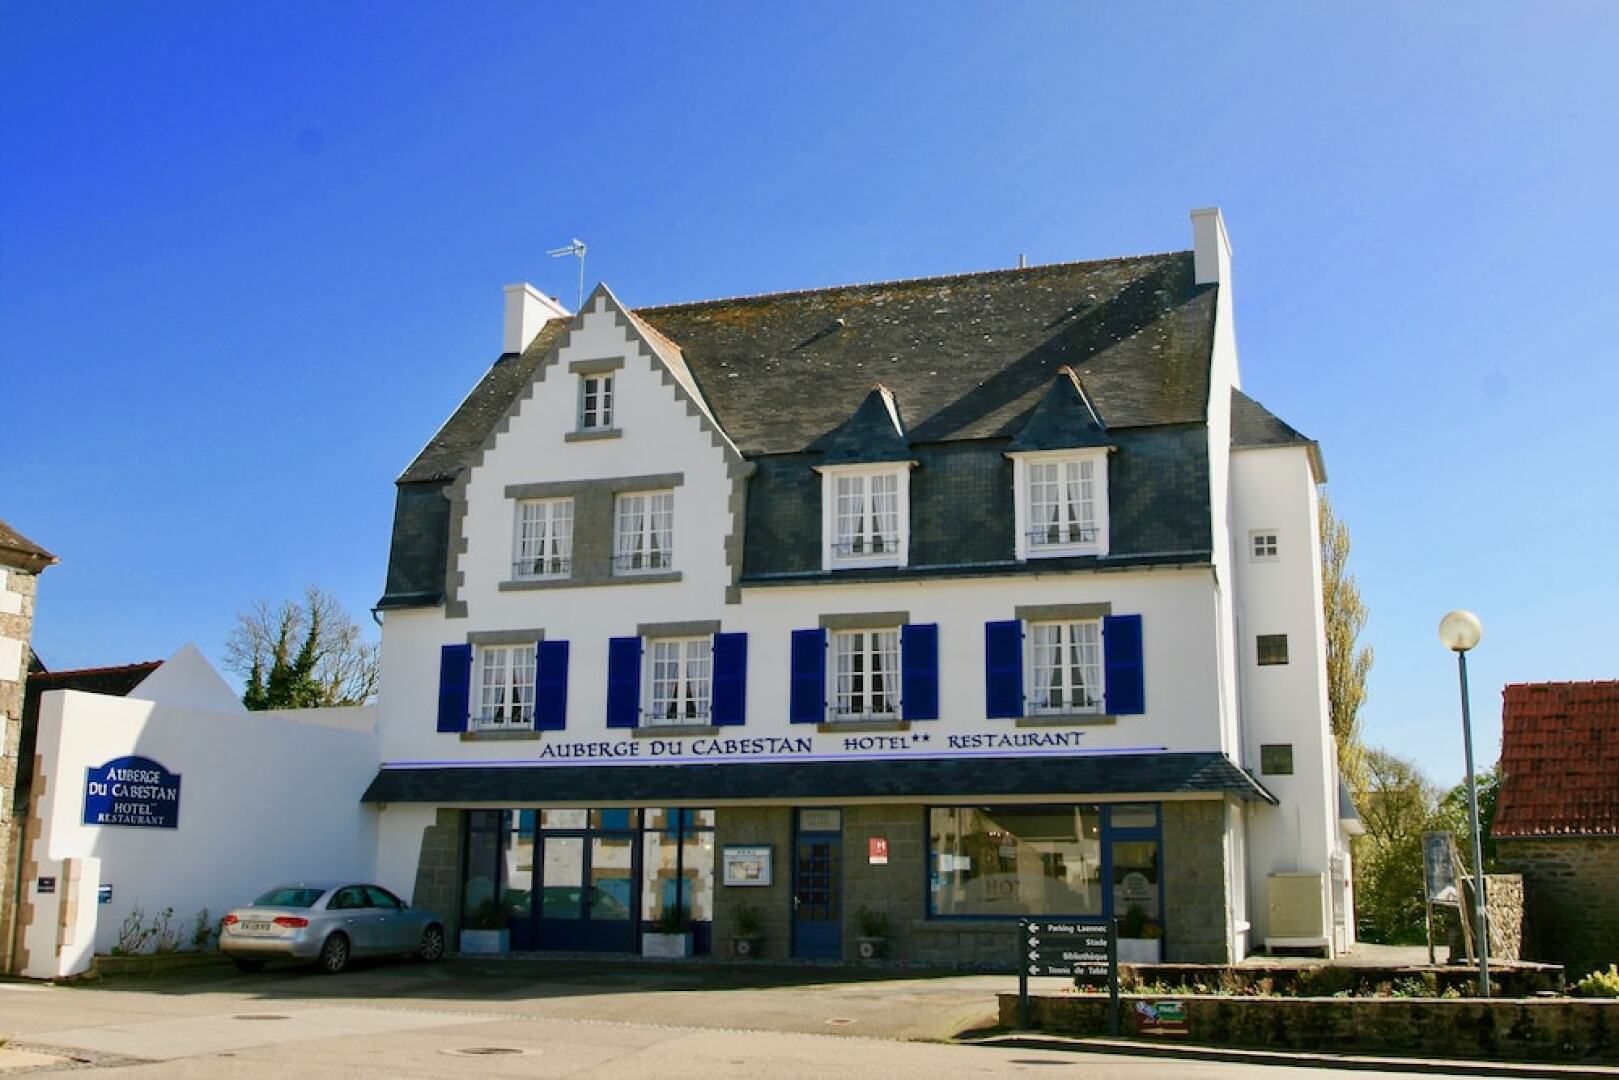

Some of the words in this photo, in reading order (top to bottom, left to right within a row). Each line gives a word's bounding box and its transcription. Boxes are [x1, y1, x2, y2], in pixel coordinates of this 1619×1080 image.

[540, 741, 640, 758] AUBERGE
[650, 740, 682, 756] DU
[692, 737, 813, 754] CABESTAN
[948, 731, 1085, 749] RESTAURANT
[106, 768, 160, 784] AUBERGE
[112, 784, 176, 800] CABESTAN
[114, 802, 153, 815] HOTEL
[97, 813, 165, 824] RESTAURANT
[1047, 924, 1074, 933] Parking
